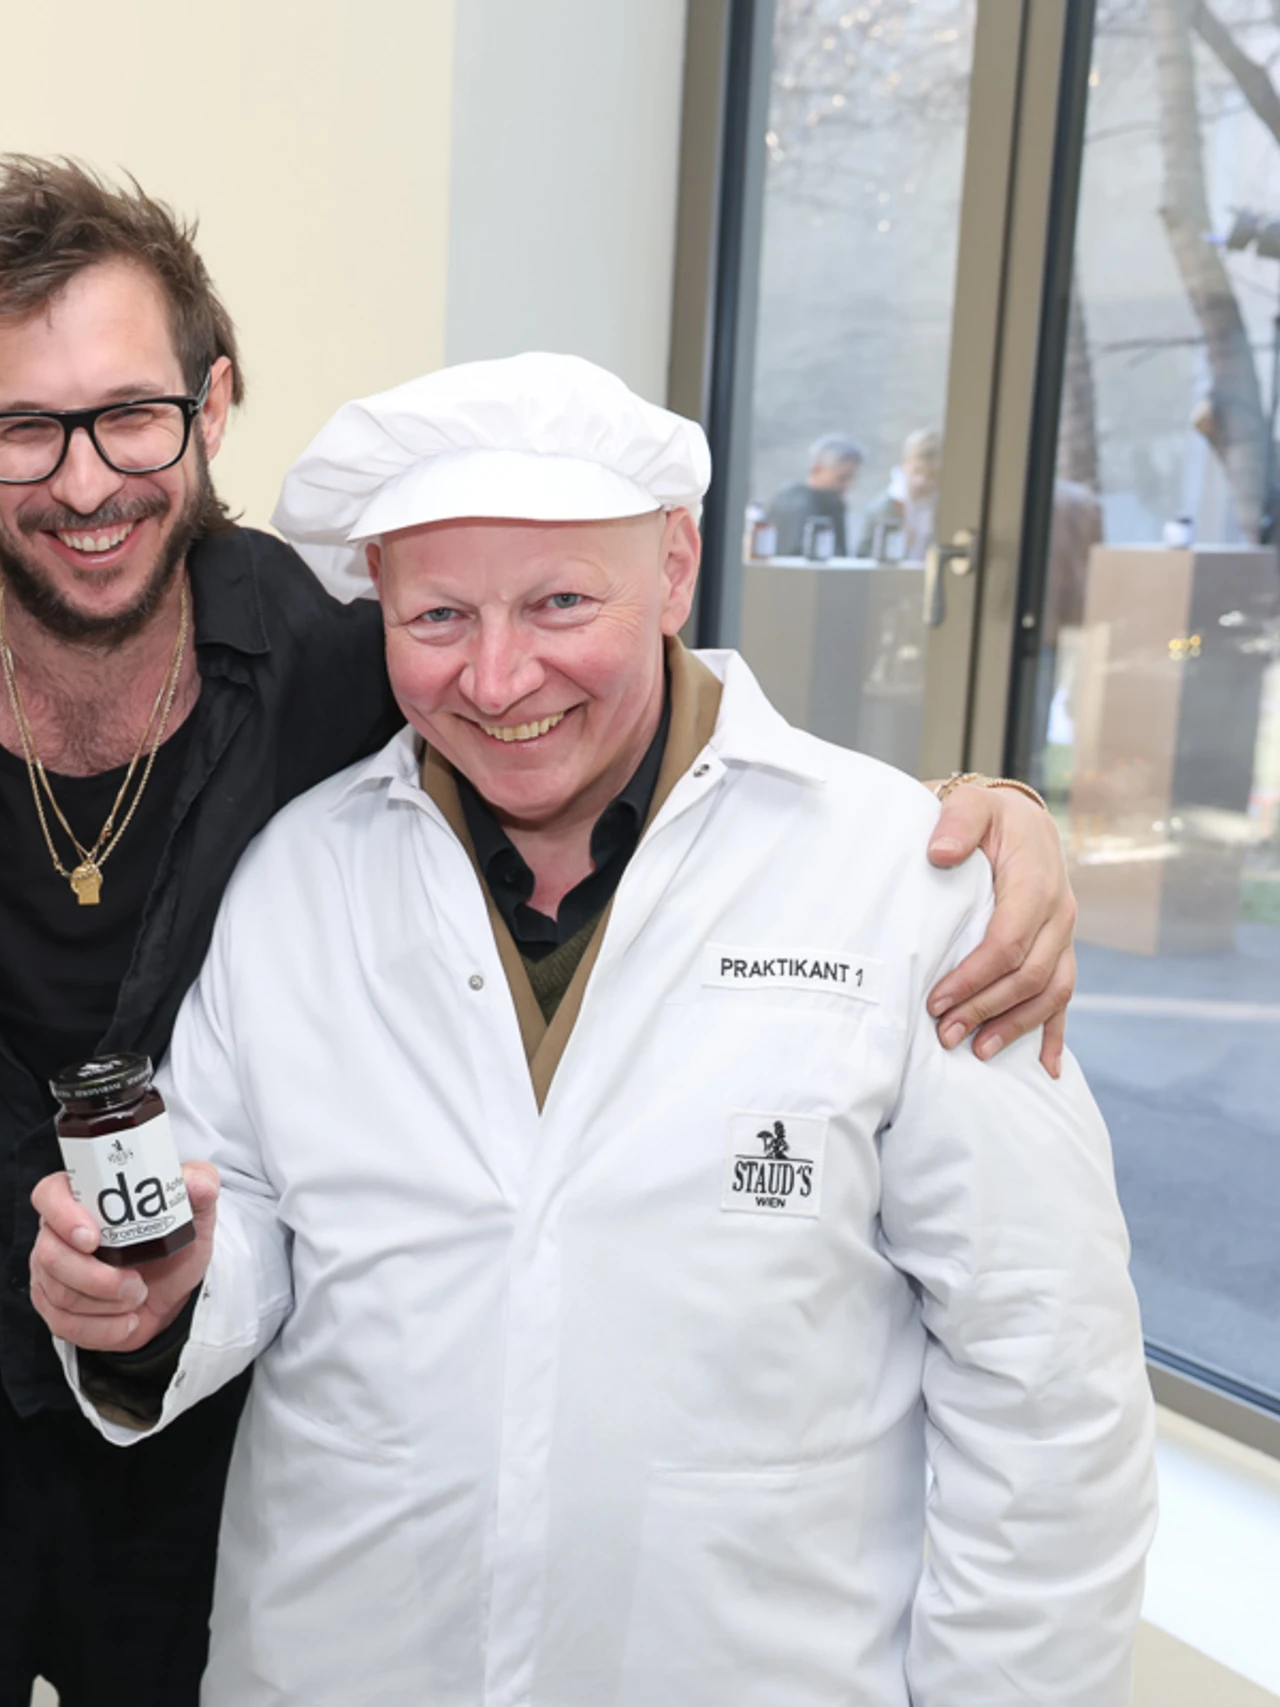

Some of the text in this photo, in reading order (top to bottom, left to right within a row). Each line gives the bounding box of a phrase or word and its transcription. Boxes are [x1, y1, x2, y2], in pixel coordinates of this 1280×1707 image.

[720, 957, 864, 987] PRAKTIKANT 1
[732, 1160, 813, 1198] STAUD'S
[97, 1171, 168, 1226] da
[755, 1196, 786, 1208] WIEN
